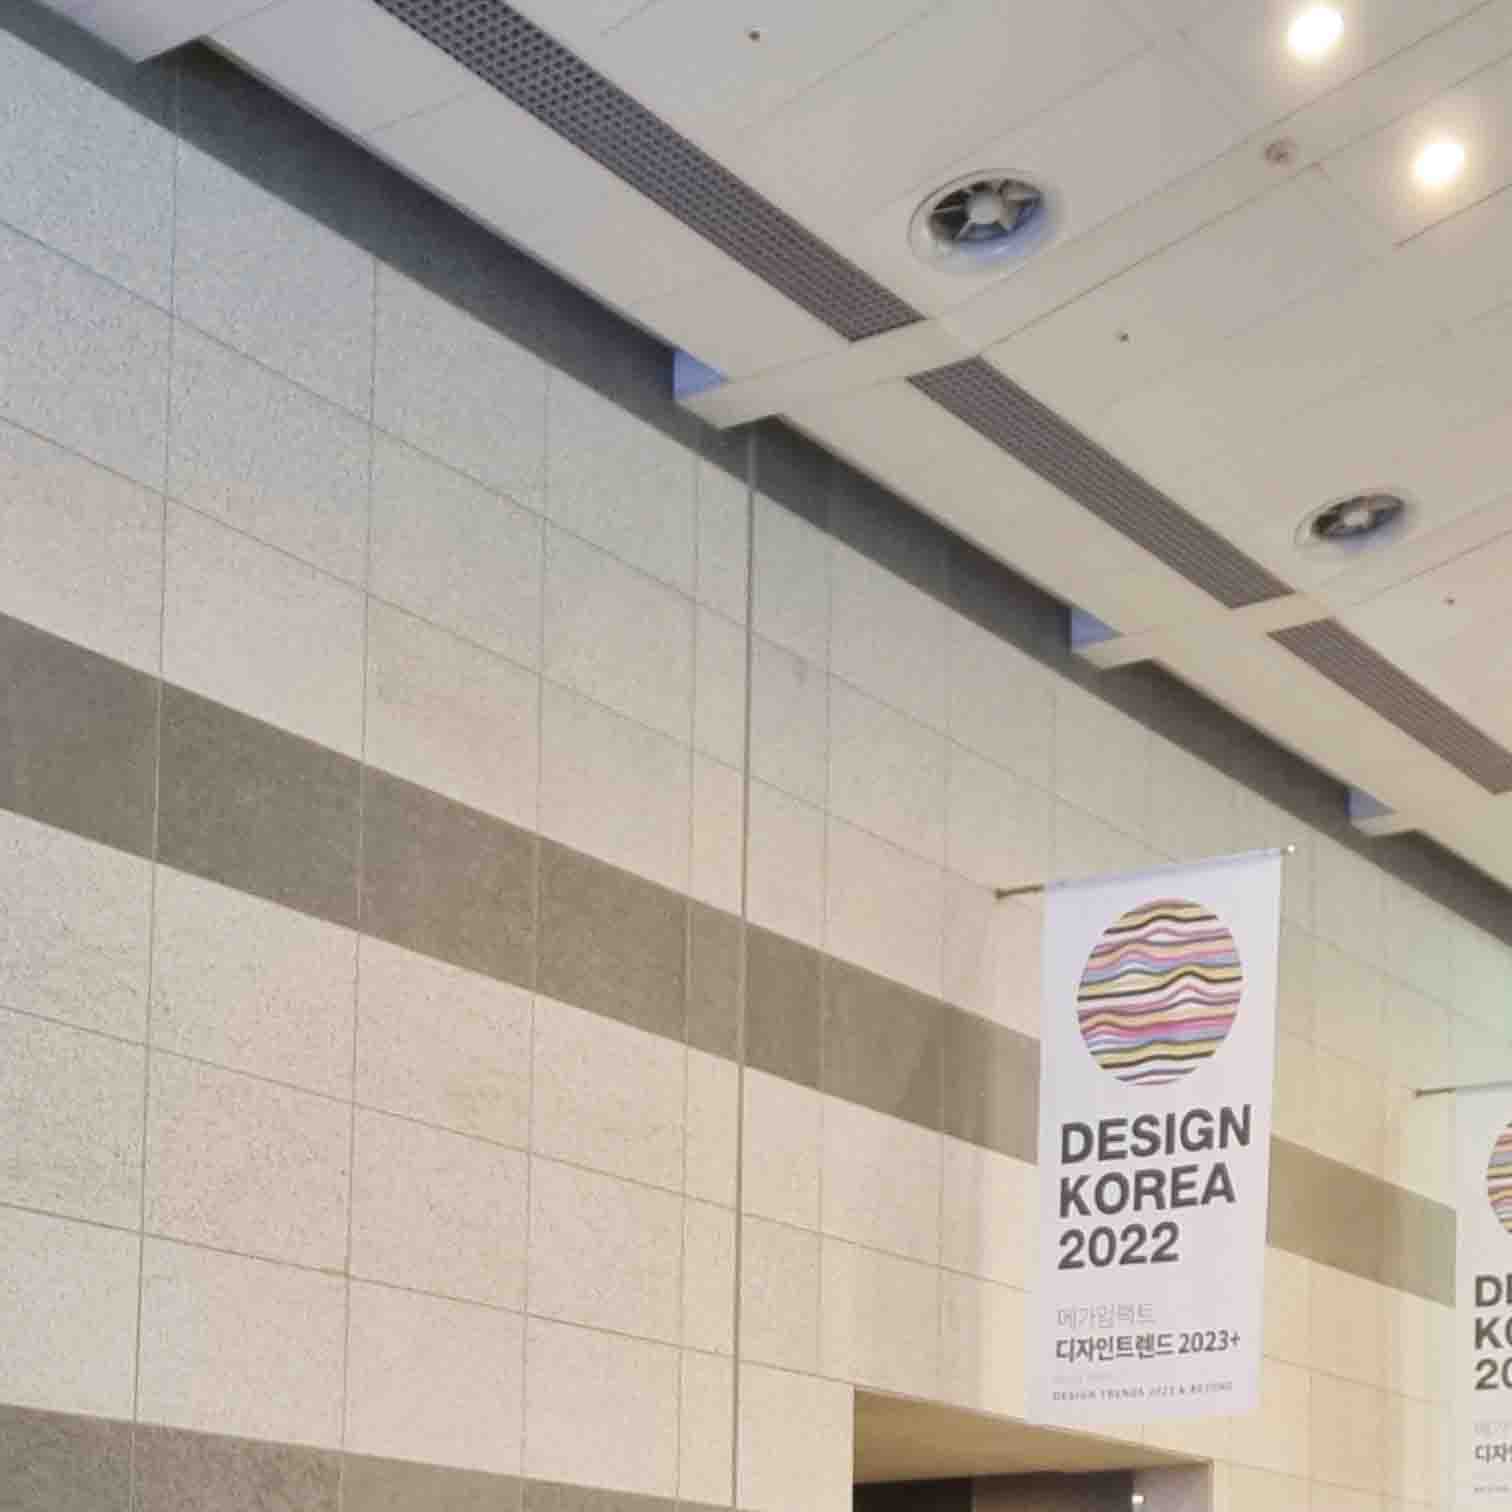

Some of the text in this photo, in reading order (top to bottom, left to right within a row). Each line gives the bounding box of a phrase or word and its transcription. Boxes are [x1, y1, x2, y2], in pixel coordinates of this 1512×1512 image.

[1060, 1103, 1251, 1165] DESIGN
[1059, 1161, 1237, 1219] KOREA
[1058, 1221, 1180, 1270] 2022
[1055, 1328, 1241, 1363] 디자인트렌드 2023+
